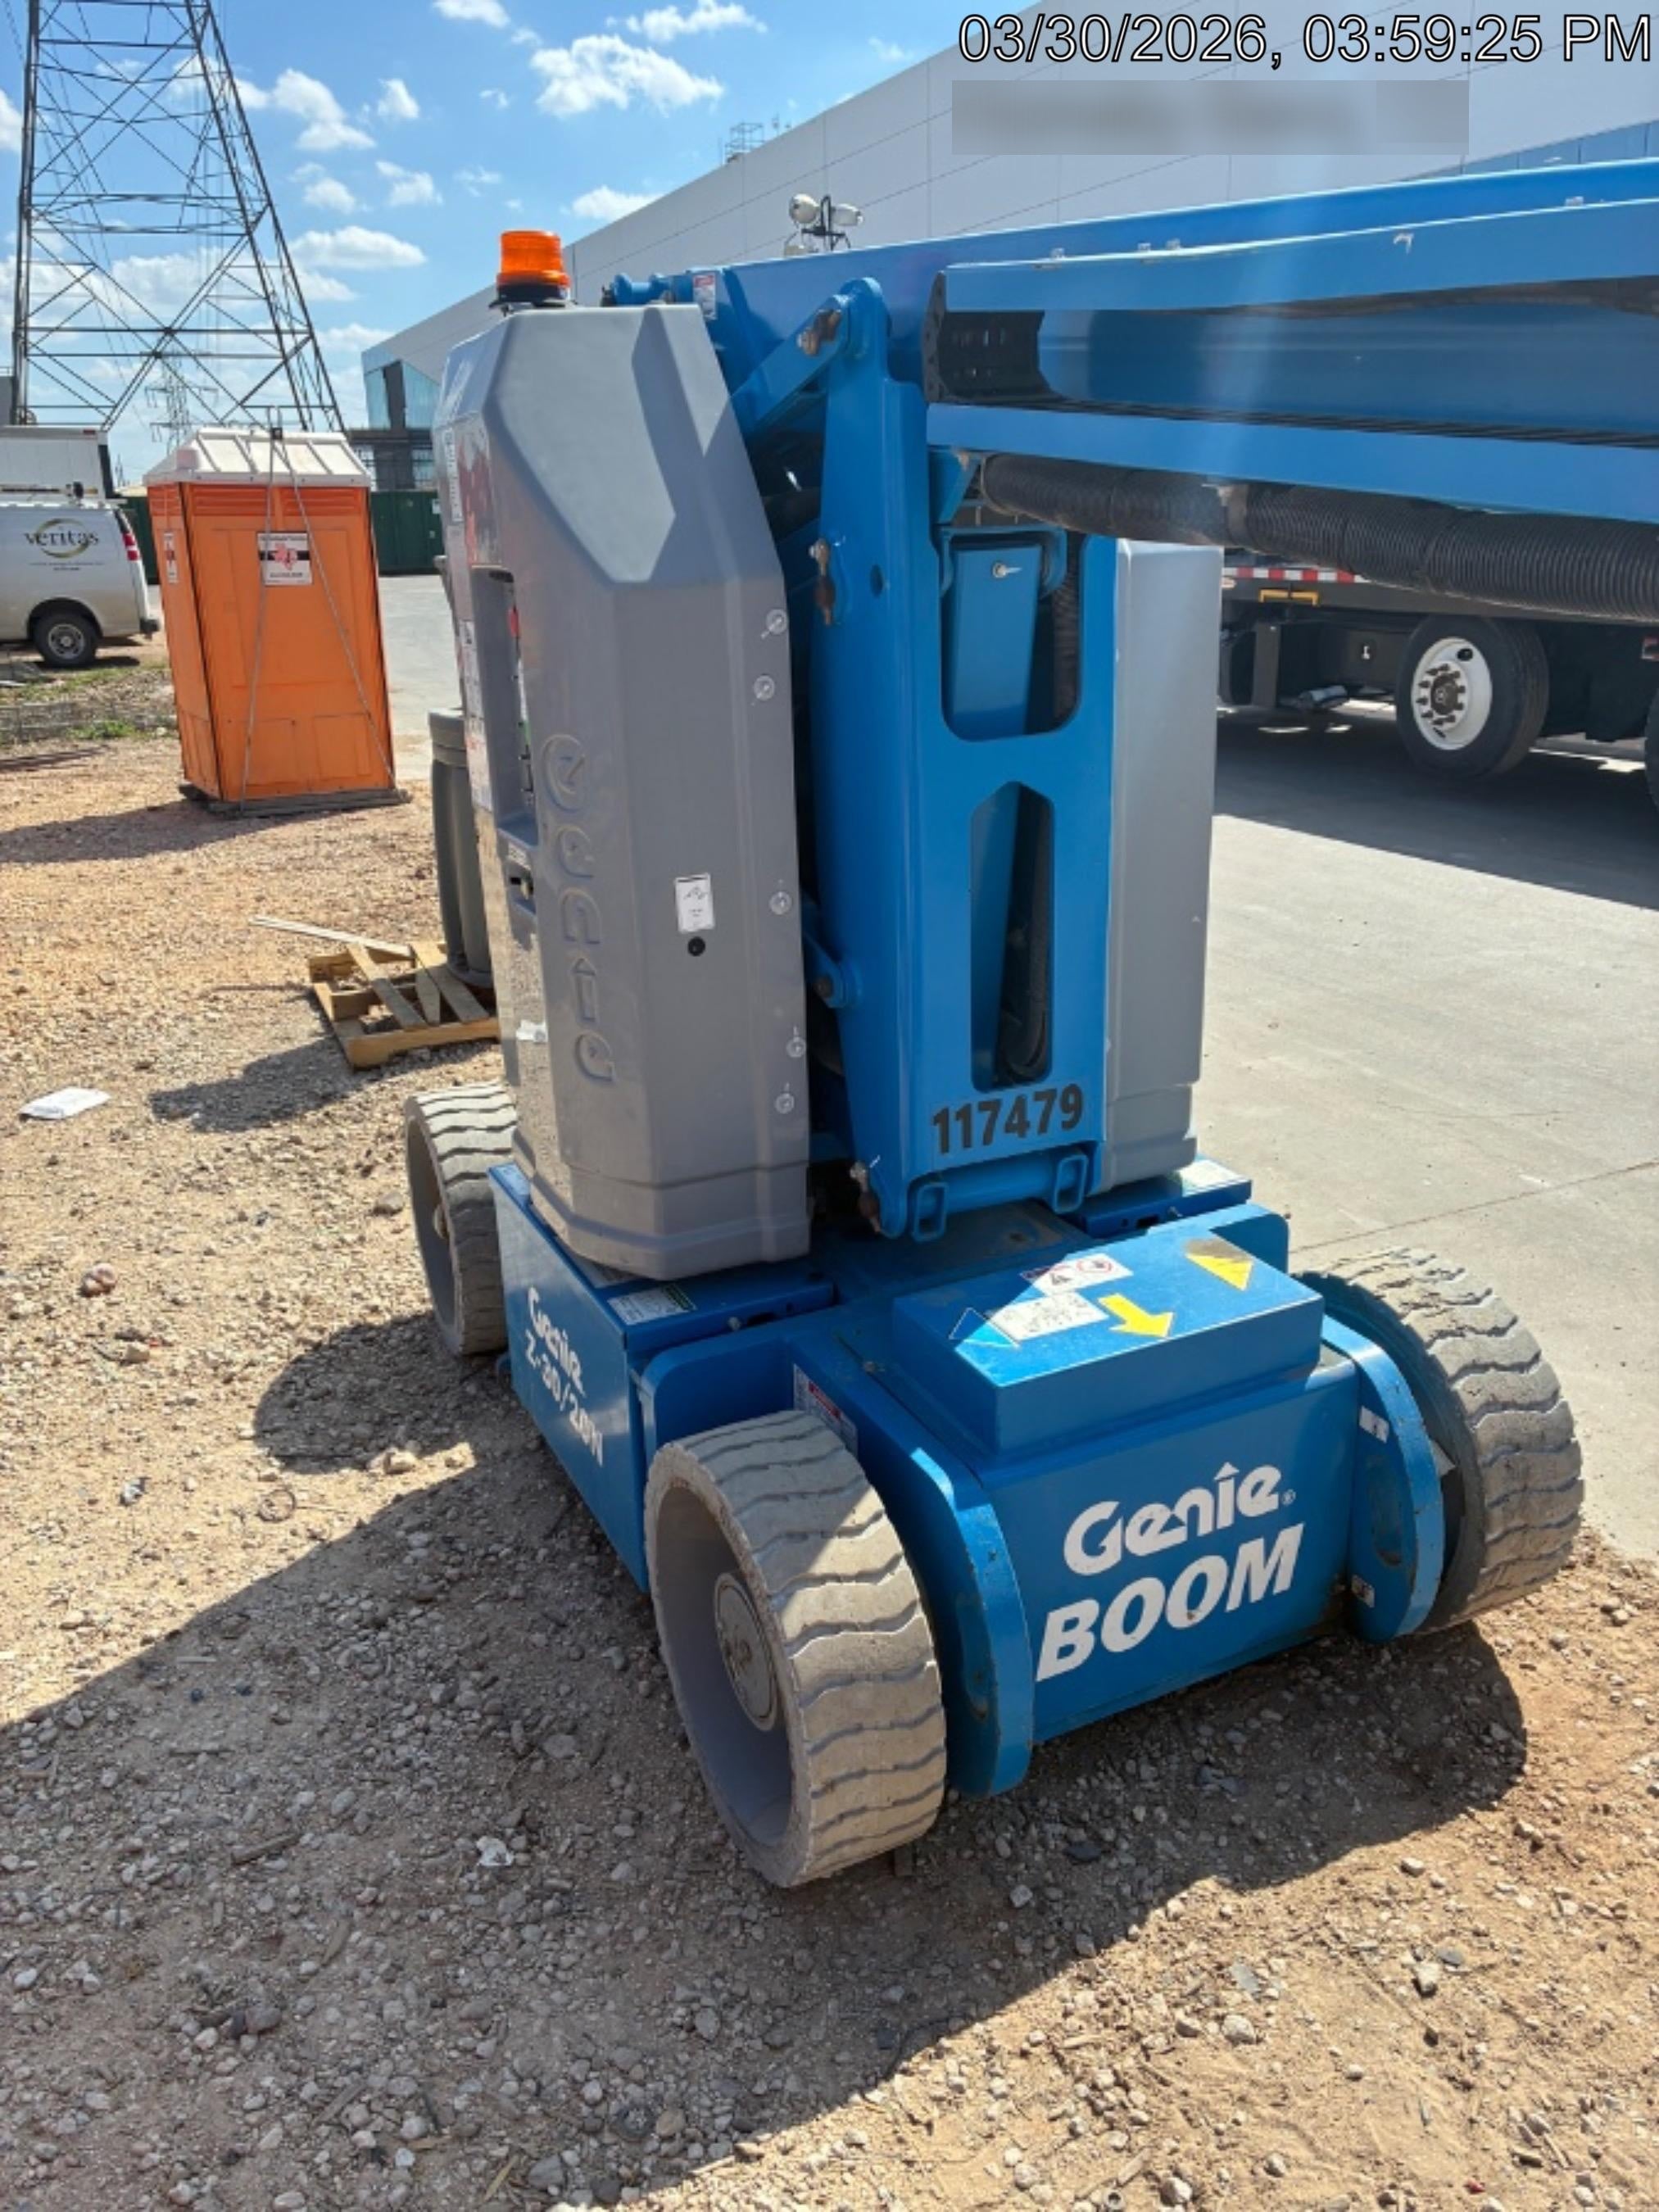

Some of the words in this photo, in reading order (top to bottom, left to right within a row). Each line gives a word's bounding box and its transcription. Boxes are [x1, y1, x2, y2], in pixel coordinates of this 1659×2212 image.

[24, 530, 99, 546] veritas
[932, 1086, 1083, 1154] 117479
[527, 1287, 587, 1398] Genie
[1036, 1523, 1304, 1682] BOOM
